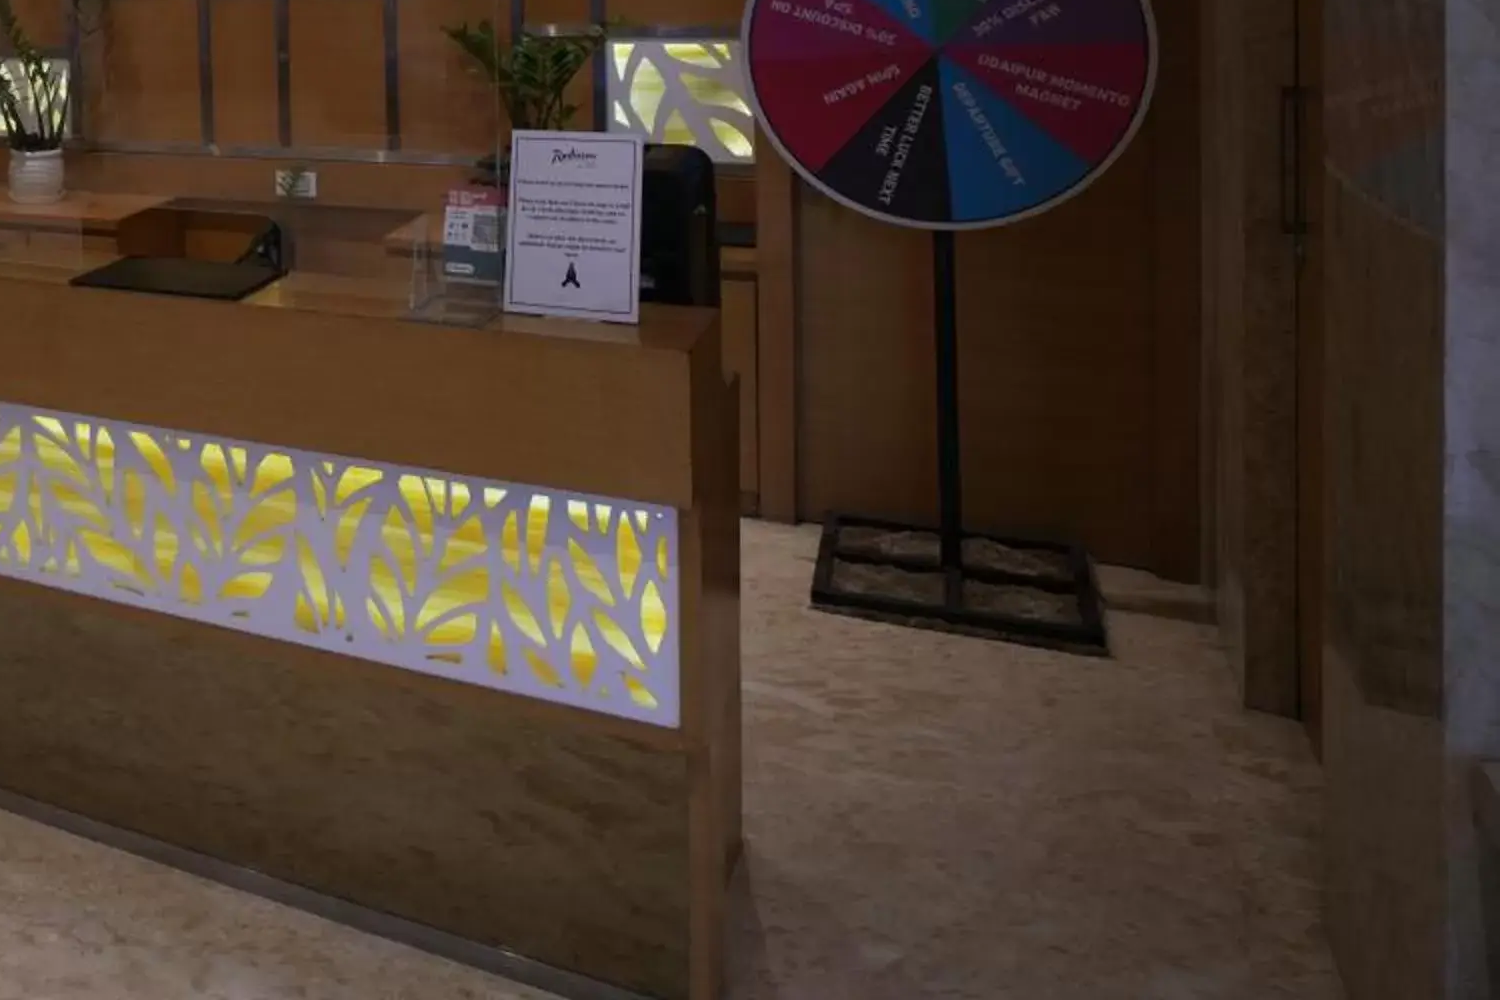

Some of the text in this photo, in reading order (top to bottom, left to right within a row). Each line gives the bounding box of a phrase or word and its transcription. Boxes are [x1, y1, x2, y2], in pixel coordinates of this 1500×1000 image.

[770, 0, 792, 15] ON
[793, 5, 864, 37] DISCOUNT
[875, 124, 898, 156] TIME
[878, 84, 933, 206] BETTER LUCK NEXT
